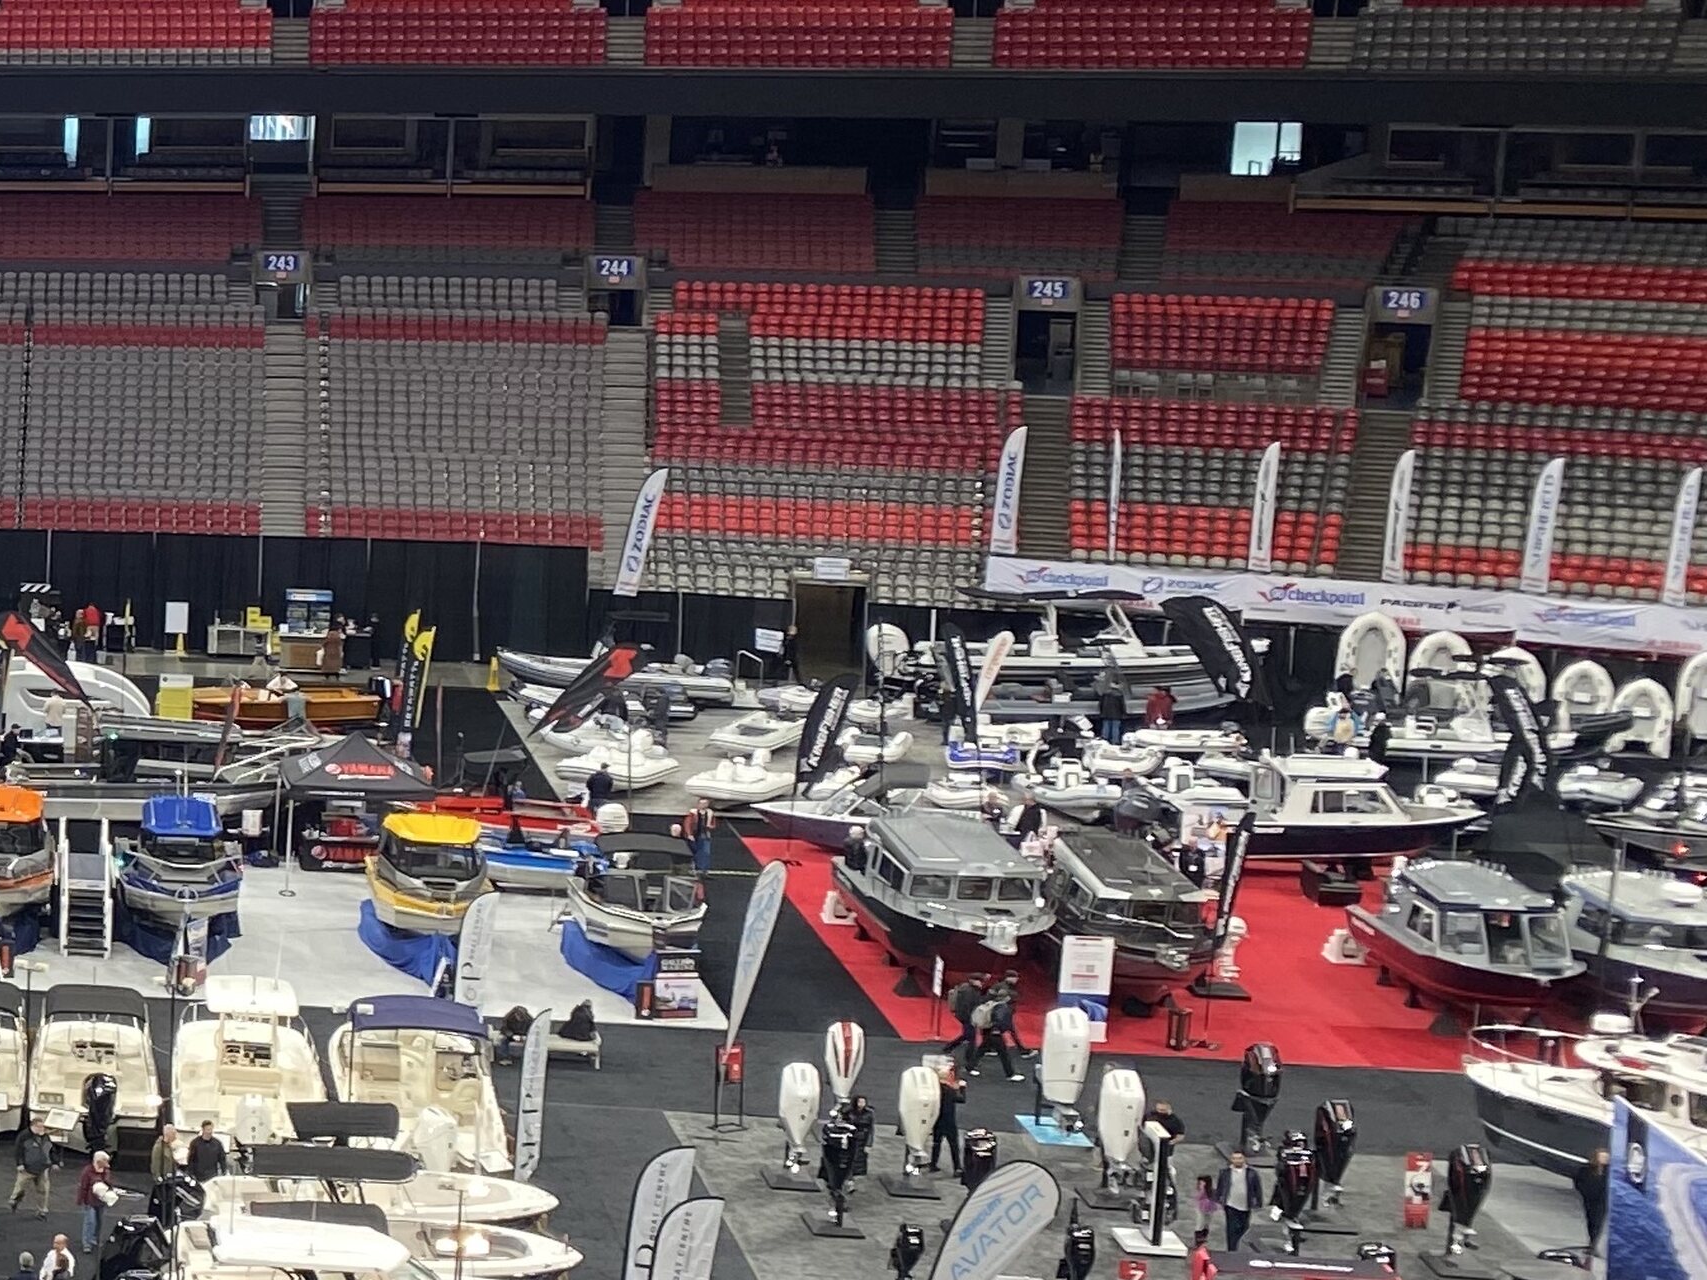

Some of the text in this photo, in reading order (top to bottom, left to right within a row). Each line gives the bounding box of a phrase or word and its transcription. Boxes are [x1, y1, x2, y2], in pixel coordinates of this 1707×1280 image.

[268, 255, 295, 271] 243
[600, 259, 629, 275] 244
[1033, 281, 1063, 298] 245
[1388, 291, 1420, 309] 246
[1000, 451, 1018, 510] ZODIAC
[631, 493, 656, 553] ZODIAC
[1041, 571, 1109, 588] checkpoint
[1287, 589, 1365, 605] checkpoint
[1203, 606, 1252, 682] KINGFISHER
[807, 686, 844, 767] KINGFISHER
